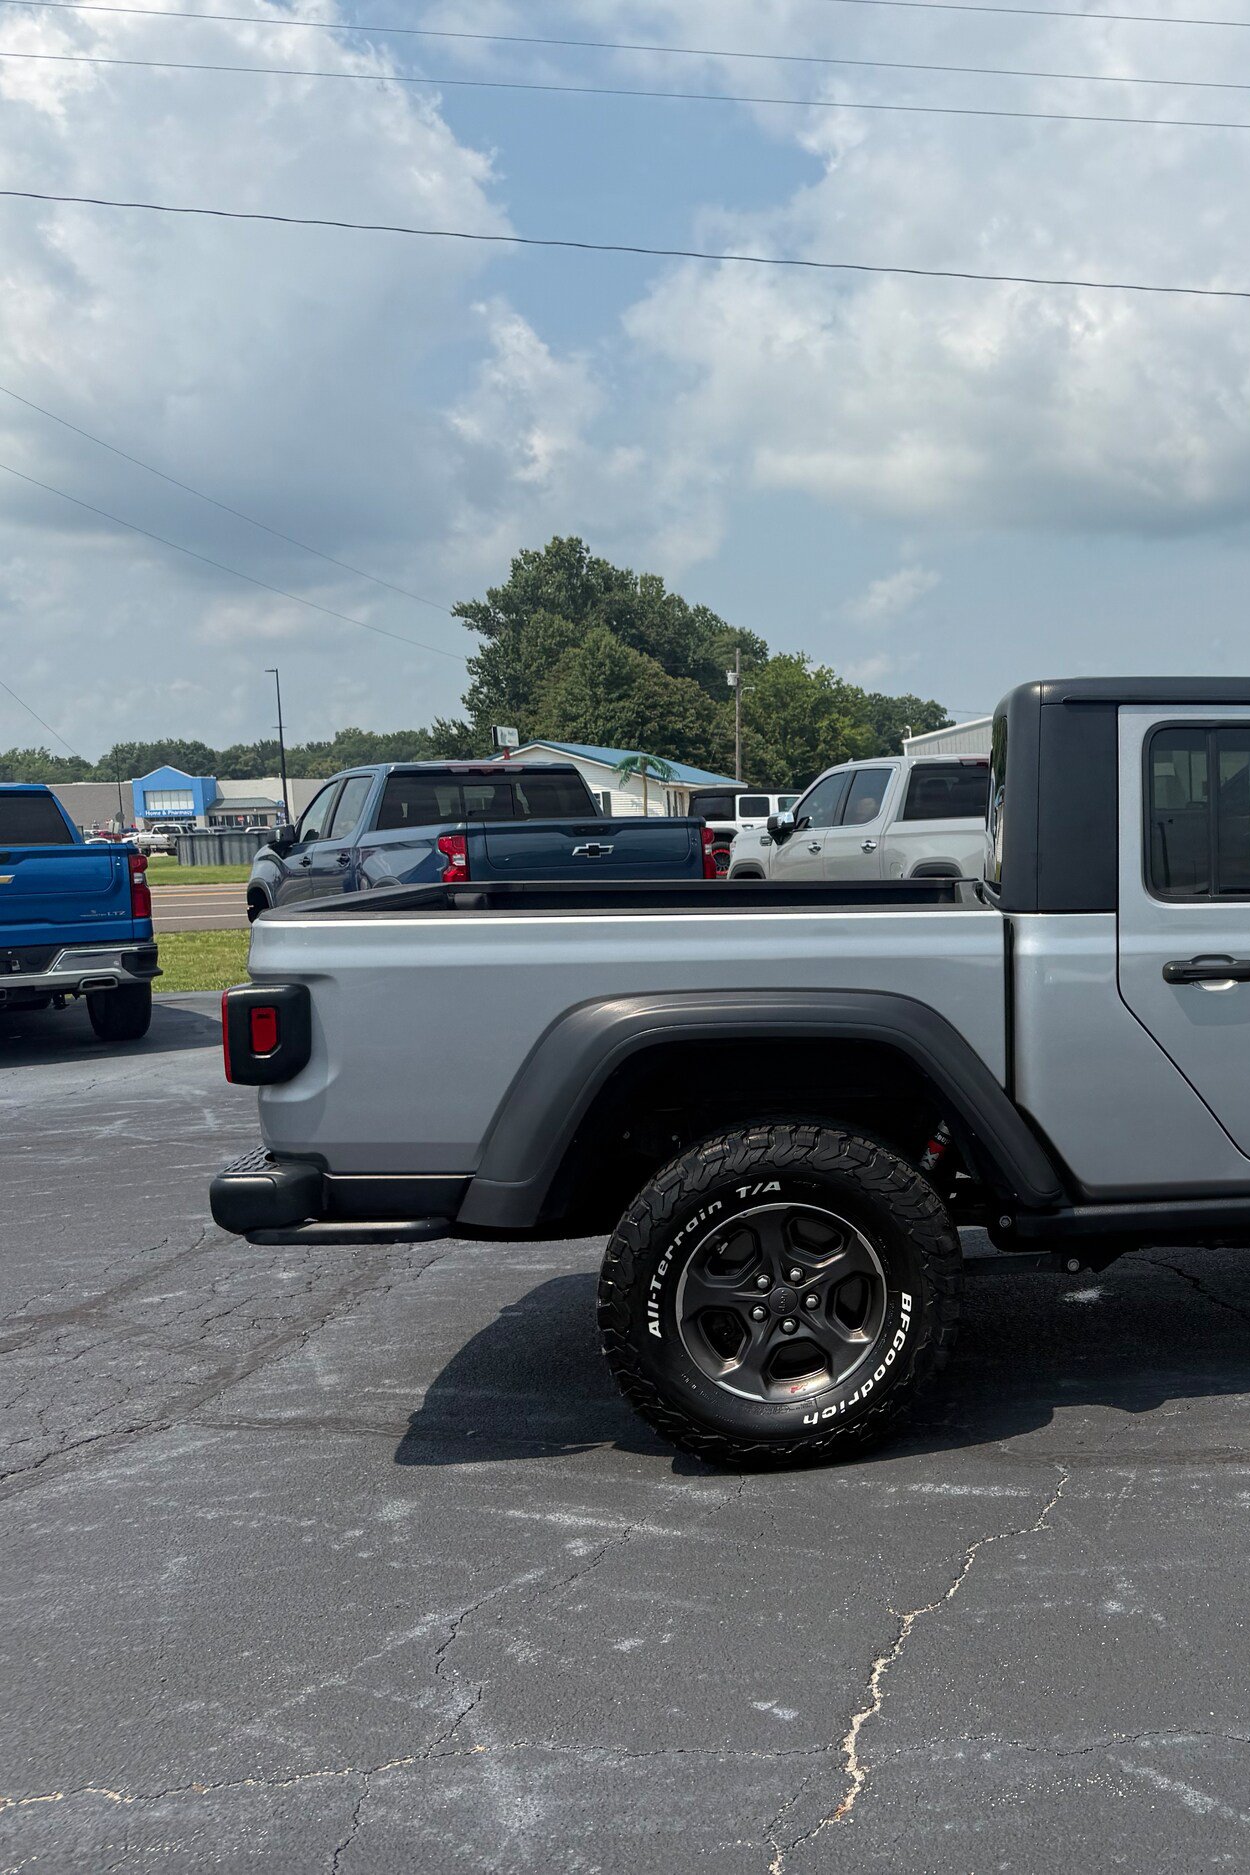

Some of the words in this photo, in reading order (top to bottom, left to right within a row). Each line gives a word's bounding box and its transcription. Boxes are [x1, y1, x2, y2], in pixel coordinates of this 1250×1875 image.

[647, 1200, 723, 1339] All-Terrain
[735, 1181, 782, 1199] T/A
[803, 1291, 912, 1425] BFGoodrich
